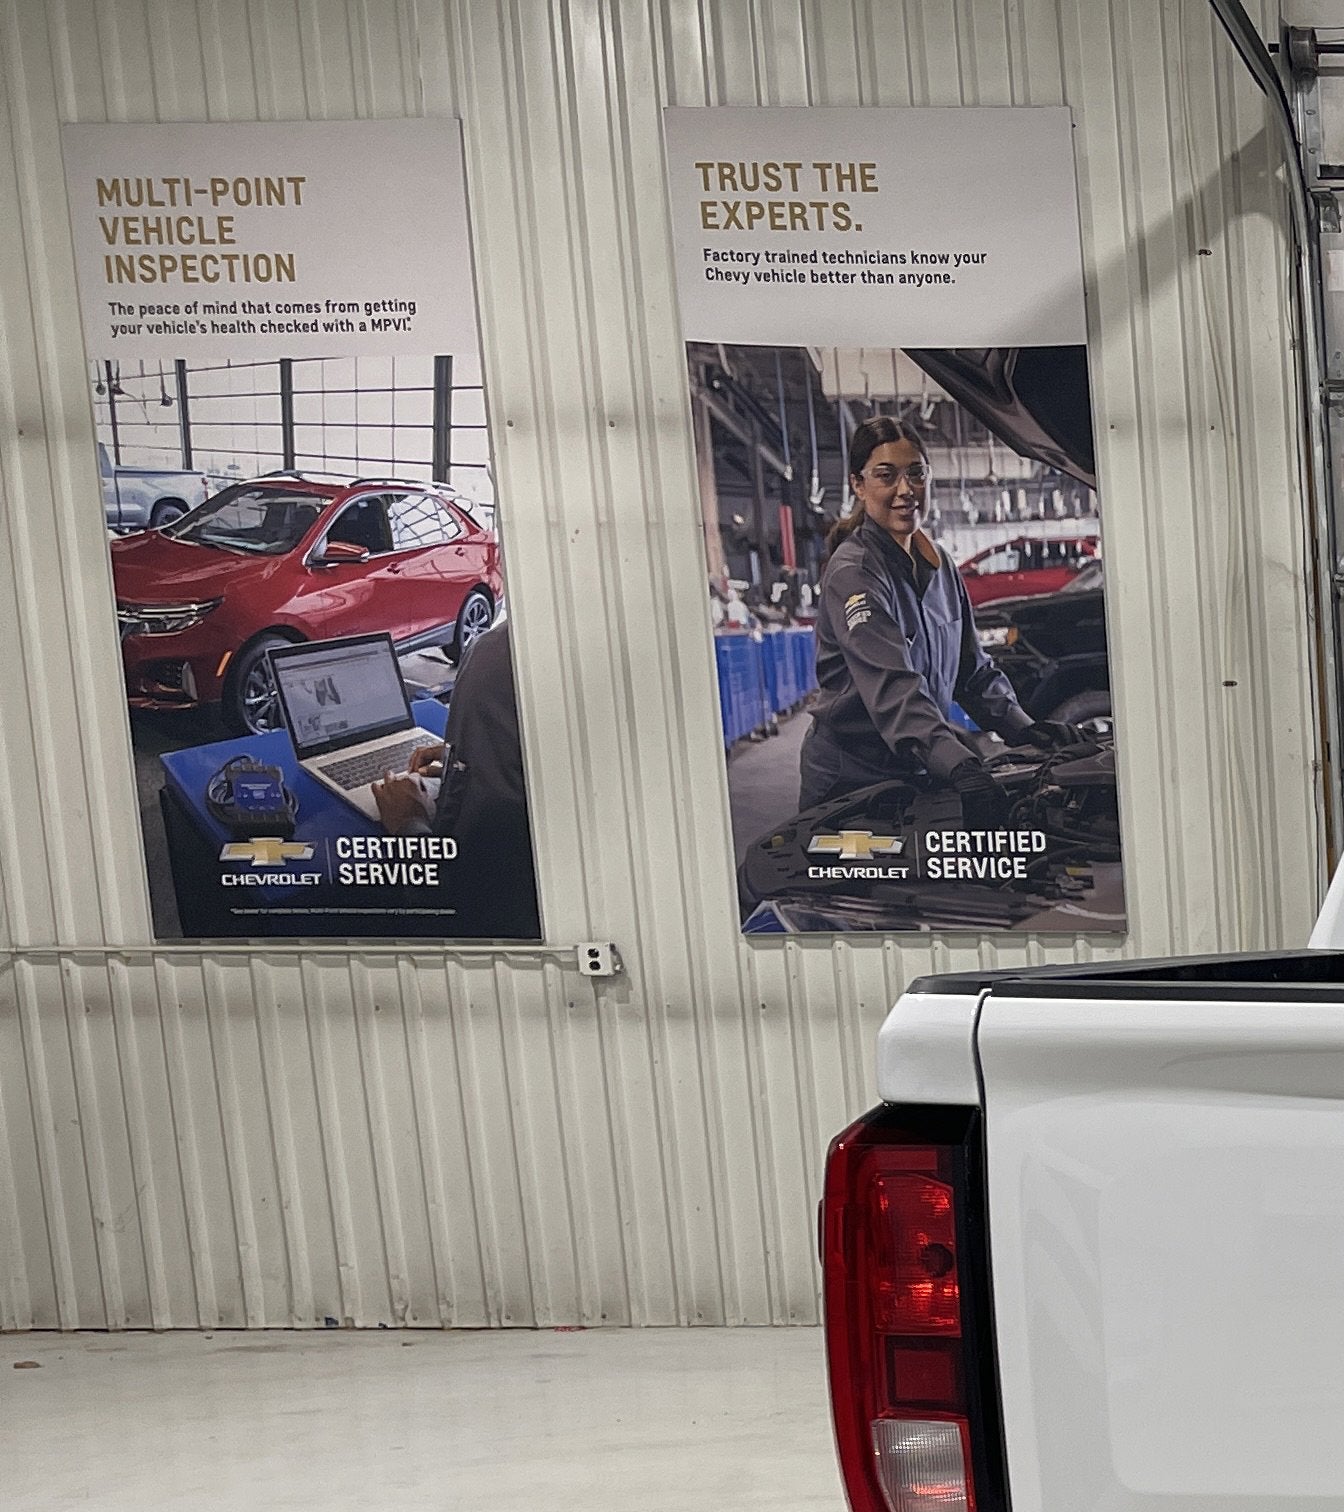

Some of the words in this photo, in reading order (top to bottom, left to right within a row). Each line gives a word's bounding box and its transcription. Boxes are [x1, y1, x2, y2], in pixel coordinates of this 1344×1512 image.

[695, 162, 802, 192] TRUST
[813, 162, 879, 192] THE
[96, 177, 306, 207] MULTI-POINT
[700, 201, 863, 231] EXPERTS.
[99, 216, 236, 245] VEHICLE
[104, 253, 296, 283] INSPECTION
[703, 249, 760, 266] Factory
[764, 249, 818, 264] trained
[822, 249, 907, 265] technicians
[910, 250, 950, 265] know
[953, 251, 988, 268] your
[705, 268, 750, 284] Chevy
[754, 269, 806, 283] vehicle
[810, 269, 857, 284] better
[860, 270, 894, 284] than
[898, 271, 956, 287] anyone.
[108, 302, 135, 316] The
[139, 303, 180, 319] peace
[184, 301, 199, 315] of
[202, 301, 238, 315] mind
[241, 301, 272, 314] that
[275, 302, 322, 315] comes
[325, 300, 360, 314] from
[364, 299, 417, 316] getting
[111, 323, 144, 338] your
[146, 320, 207, 335] vehicle's
[211, 320, 256, 334] health
[260, 319, 319, 334] checked
[322, 318, 355, 333] with
[358, 321, 368, 332] a
[336, 837, 457, 860] CERTIFIED
[925, 831, 1046, 853] CERTIFIED
[338, 864, 440, 886] SERVICE
[808, 866, 909, 879] CHEVROLET
[927, 857, 1027, 879] SERVICE
[221, 873, 322, 886] CHEVROLET
